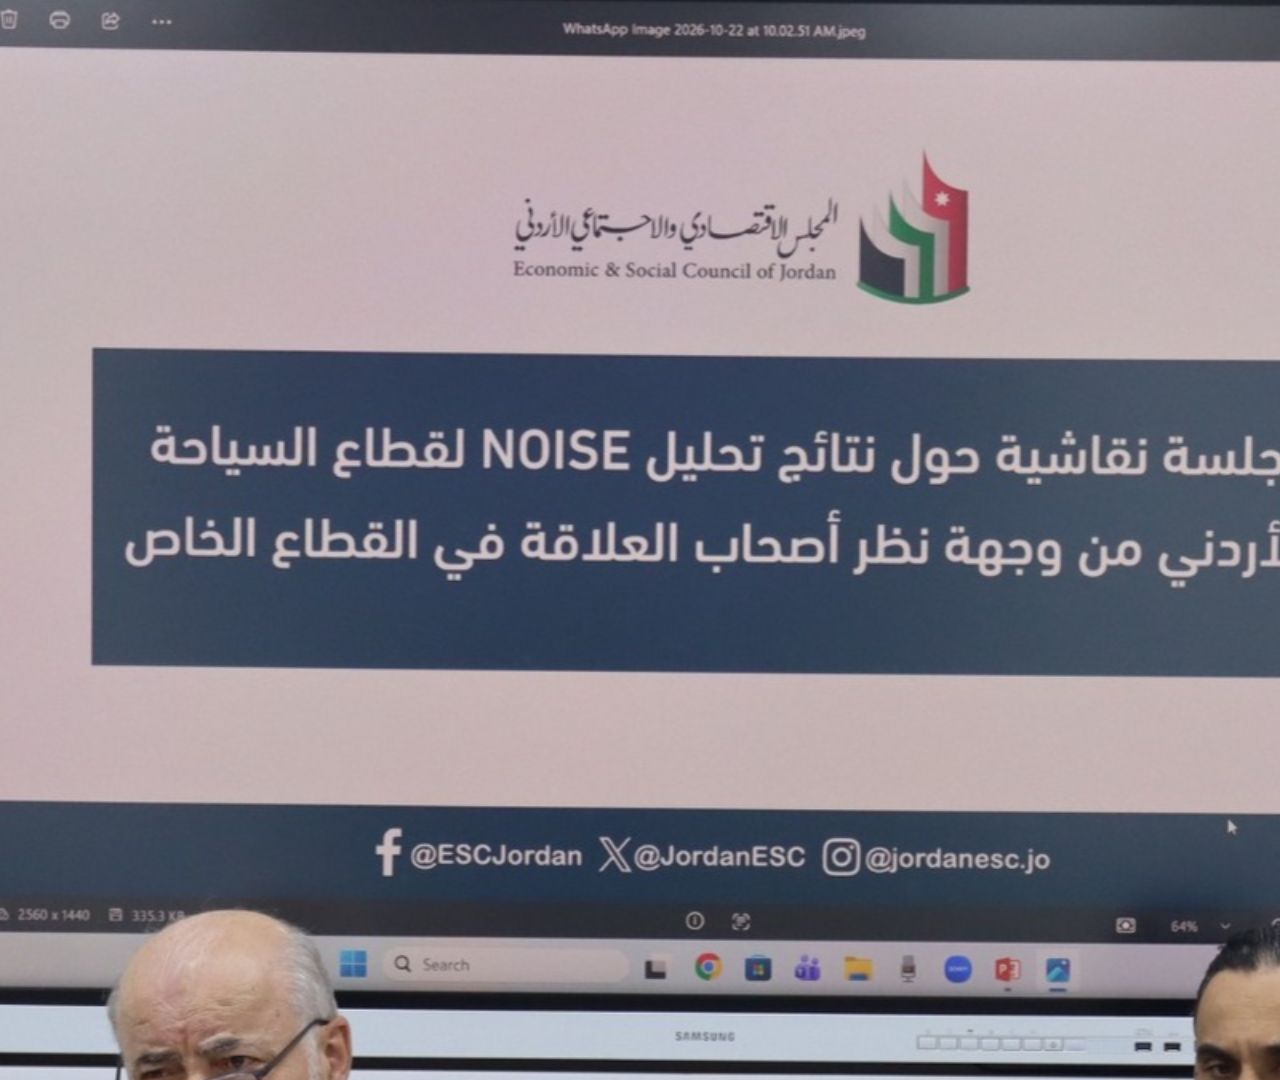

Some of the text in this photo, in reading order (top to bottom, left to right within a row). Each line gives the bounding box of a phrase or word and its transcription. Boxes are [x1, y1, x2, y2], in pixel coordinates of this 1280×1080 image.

[563, 22, 628, 37] WhatsApp
[632, 23, 671, 38] Image
[674, 23, 744, 37] 2026-10-22
[747, 25, 760, 36] at
[777, 197, 839, 258] المجلس
[513, 260, 837, 283] Economic & Social Council of Jordan
[150, 424, 317, 477] السياحة
[332, 427, 465, 479] لقطاع
[482, 428, 631, 471] NOISE
[646, 430, 765, 483] تحليل
[778, 430, 875, 483] نتائج
[891, 432, 980, 485] حول
[996, 430, 1147, 486] نقاشية
[125, 516, 256, 568] الخاص
[272, 518, 418, 569] القطاع
[434, 523, 505, 582] في
[520, 521, 678, 564] العلاقة
[695, 509, 842, 575] أصحاب
[853, 523, 929, 576] نظر
[944, 525, 1062, 578] وجهة
[1079, 536, 1142, 578] من
[410, 842, 583, 871] @ESCJordan
[634, 844, 807, 871] @JordanESC
[865, 846, 1051, 875] @jordanesc.jo
[17, 908, 48, 921] 2560
[62, 908, 91, 921] 1440
[1169, 920, 1199, 933] 64%
[422, 956, 470, 973] Search
[674, 1031, 736, 1042] SAMSUNG
